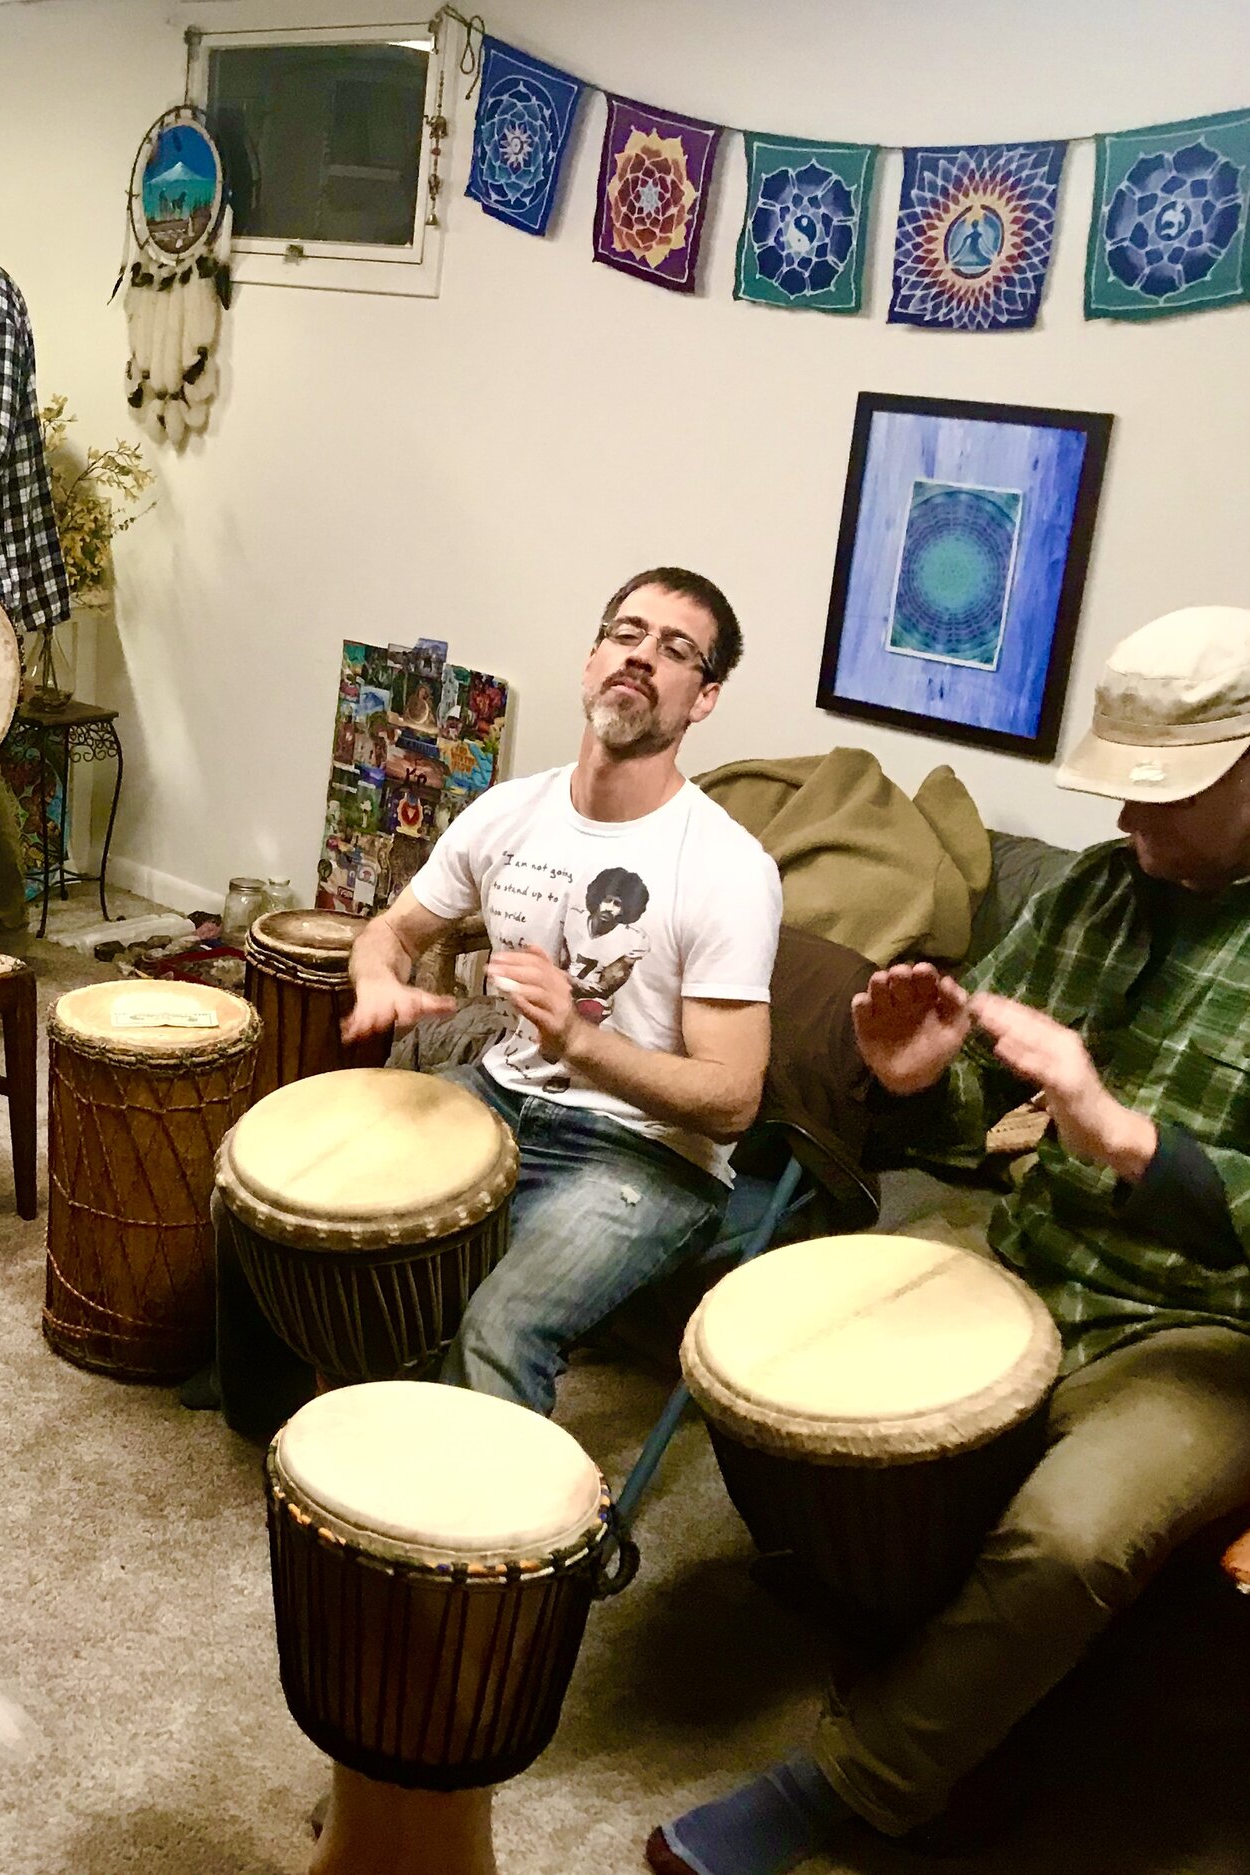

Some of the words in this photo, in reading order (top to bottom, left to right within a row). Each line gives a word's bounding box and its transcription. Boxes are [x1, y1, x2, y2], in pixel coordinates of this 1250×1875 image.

[532, 863, 548, 872] not
[550, 868, 573, 883] going
[493, 881, 501, 890] to
[503, 884, 529, 896] stand
[532, 891, 542, 901] up
[547, 892, 558, 903] to
[505, 911, 526, 923] pride
[576, 953, 599, 979] 7
